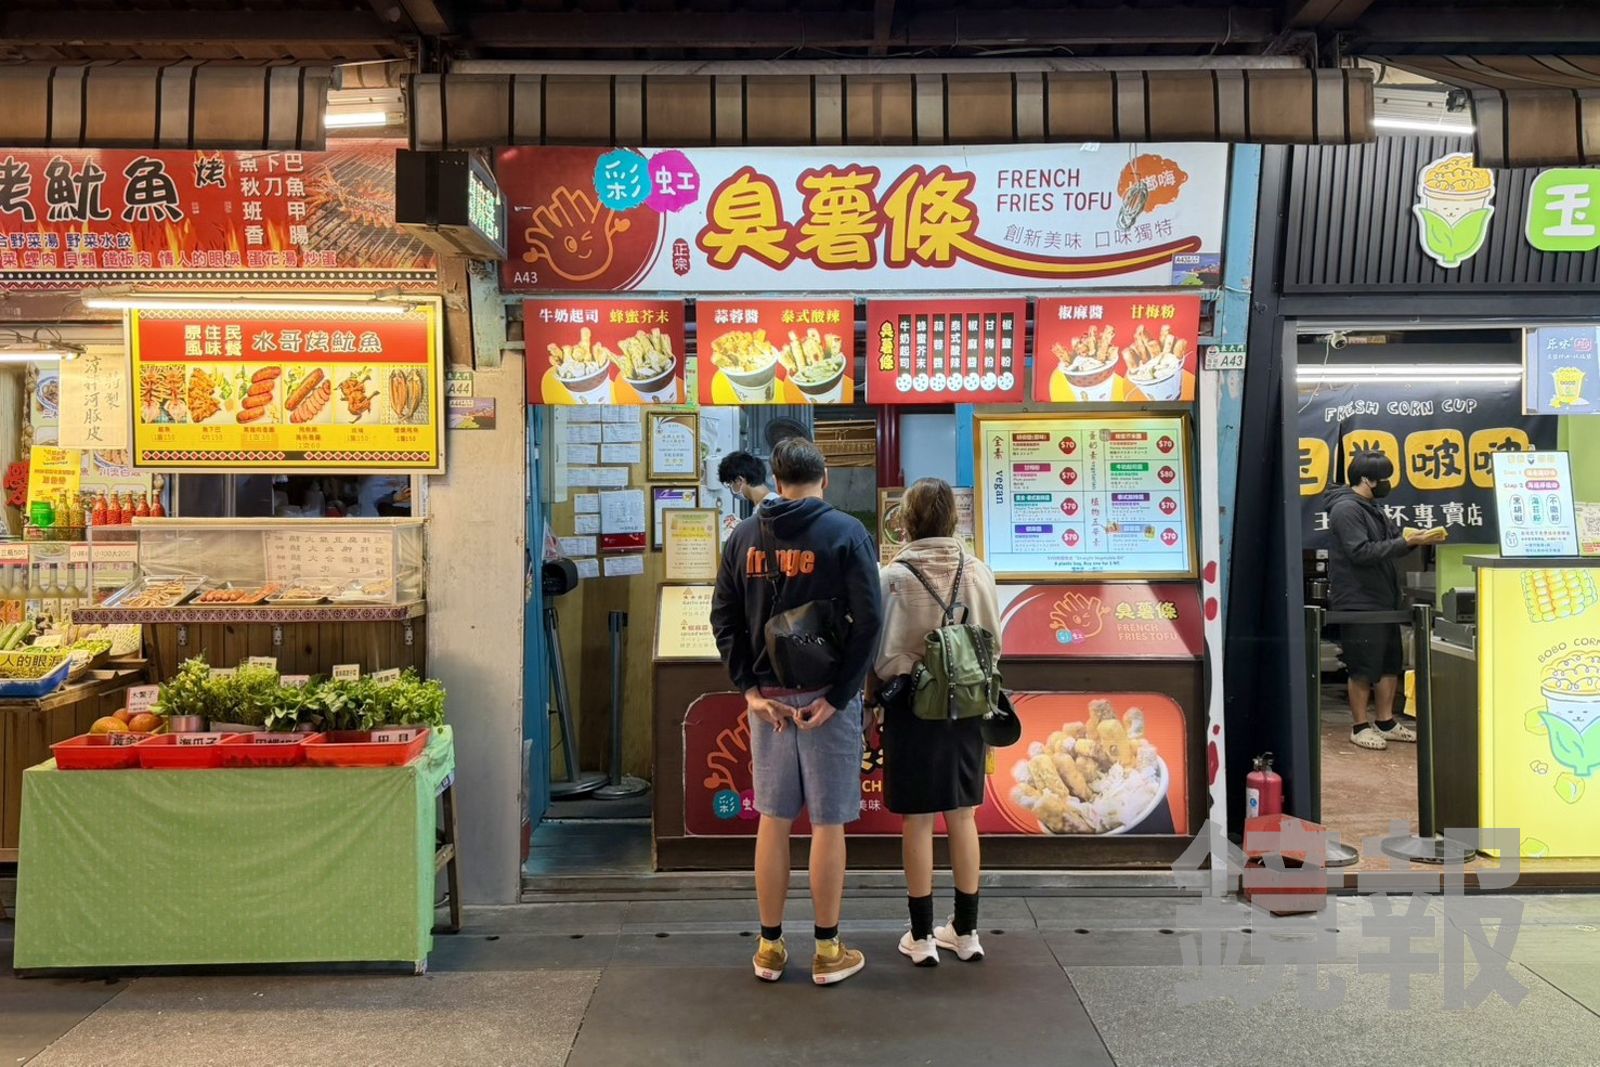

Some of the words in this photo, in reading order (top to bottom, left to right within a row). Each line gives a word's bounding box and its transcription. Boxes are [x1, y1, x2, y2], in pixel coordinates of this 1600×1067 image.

[241, 176, 305, 197] 秋刀魚
[604, 160, 696, 200] 彩虹
[997, 168, 1080, 189] FRENCH
[997, 193, 1054, 213] FRIES
[1063, 192, 1112, 211] TOFU
[1542, 183, 1596, 237] 玉
[700, 169, 974, 266] 臭薯條
[66, 233, 131, 248] 野菜水餃
[245, 224, 308, 245] 香腸
[1003, 224, 1082, 249] 創新美味
[1095, 218, 1173, 248] 口味獨特
[65, 251, 95, 266] 貝類
[247, 250, 297, 266] 蛋花湯
[303, 251, 337, 266] 炒蛋
[673, 242, 690, 272] 正宗
[514, 272, 539, 284] A43
[539, 308, 599, 324] 牛奶起司
[609, 309, 670, 324] 蜂蜜芥末
[714, 309, 760, 324] 蒜蓉醬
[781, 309, 841, 324] 泰式酸辣
[1058, 304, 1104, 320] 椒麻醬
[1131, 304, 1176, 320] 甘梅粉
[184, 325, 243, 340] 原住民
[253, 330, 383, 353] 水哥烤魷魚
[184, 340, 243, 356] 風味餐
[878, 320, 896, 371] 臭薯條
[900, 320, 911, 369] 牛奶起司
[916, 320, 927, 369] 蜂蜜芥末
[950, 320, 961, 368] 泰式酸辣
[984, 320, 995, 368] 甘梅粉
[1221, 356, 1244, 366] A43
[448, 383, 470, 394] A44
[1325, 400, 1380, 422] FRESH
[1387, 400, 1434, 416] CORN
[1441, 398, 1478, 414] CUP
[1060, 441, 1075, 449] $70
[994, 470, 1004, 504] vegan
[1063, 502, 1077, 510] $70
[1161, 502, 1175, 510] $70
[1114, 601, 1178, 620] 臭薯條
[1117, 623, 1159, 632] FRENCH
[1118, 632, 1149, 641] FRIES
[1150, 632, 1178, 641] TOFU
[1537, 642, 1567, 663] BOBO
